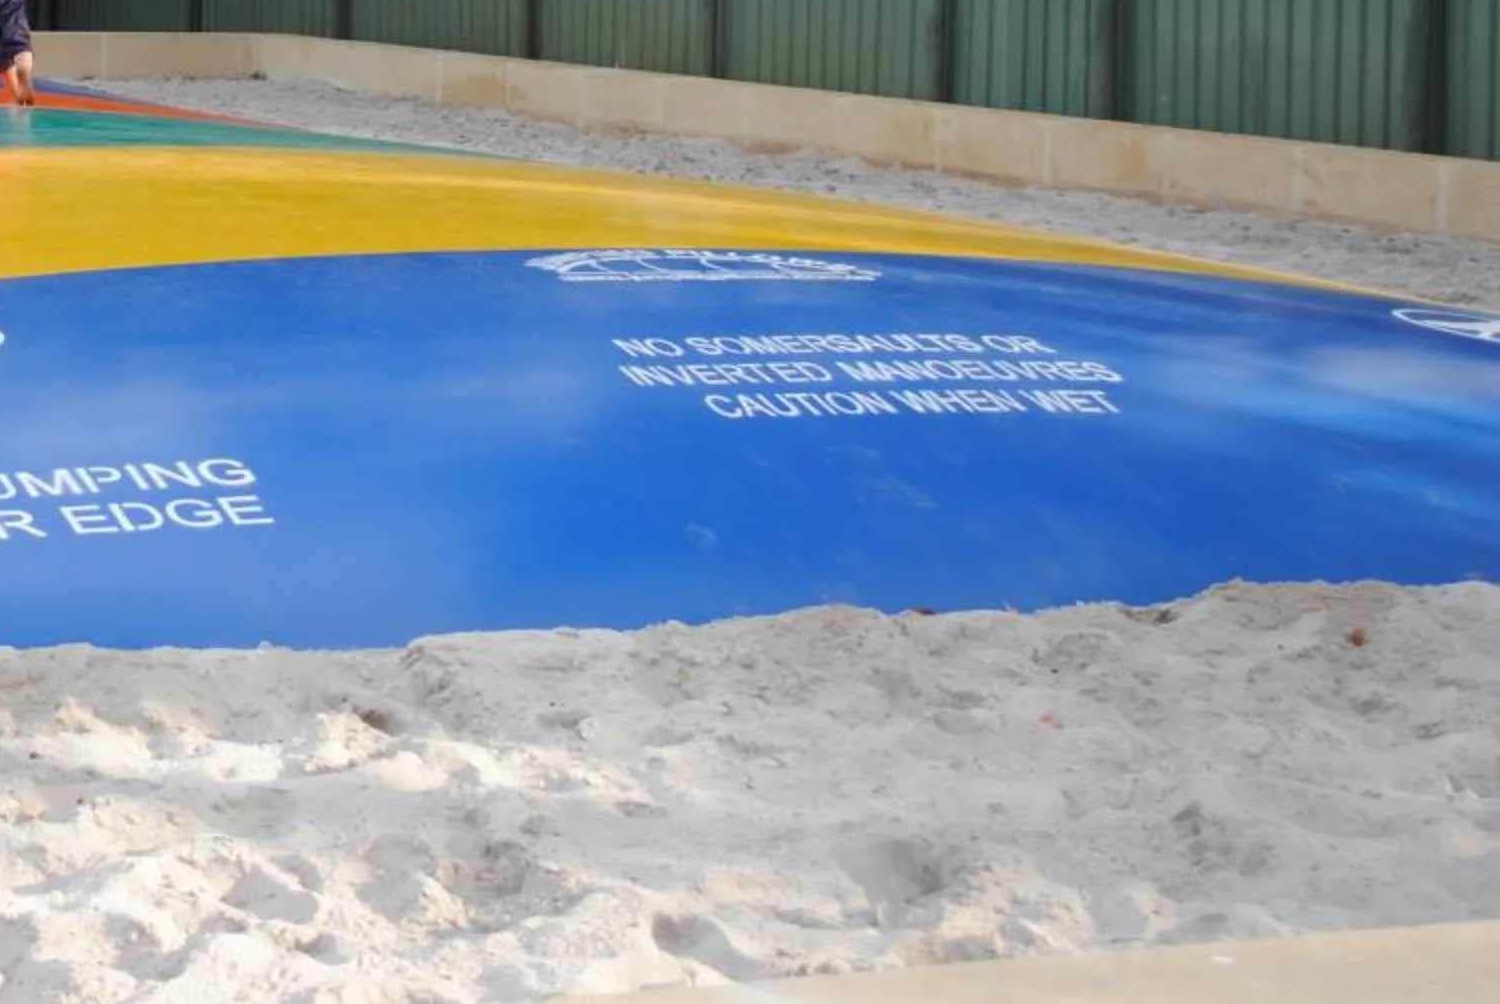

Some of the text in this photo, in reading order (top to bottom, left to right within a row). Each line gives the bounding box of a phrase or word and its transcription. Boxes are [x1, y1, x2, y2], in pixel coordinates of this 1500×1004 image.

[611, 334, 1056, 357] NO SOMERSAULTS OR
[618, 360, 1124, 386] INVERTED MANOEUVRES
[704, 390, 1122, 418] CAUTION WHEN WET
[60, 494, 274, 534] EDGE
